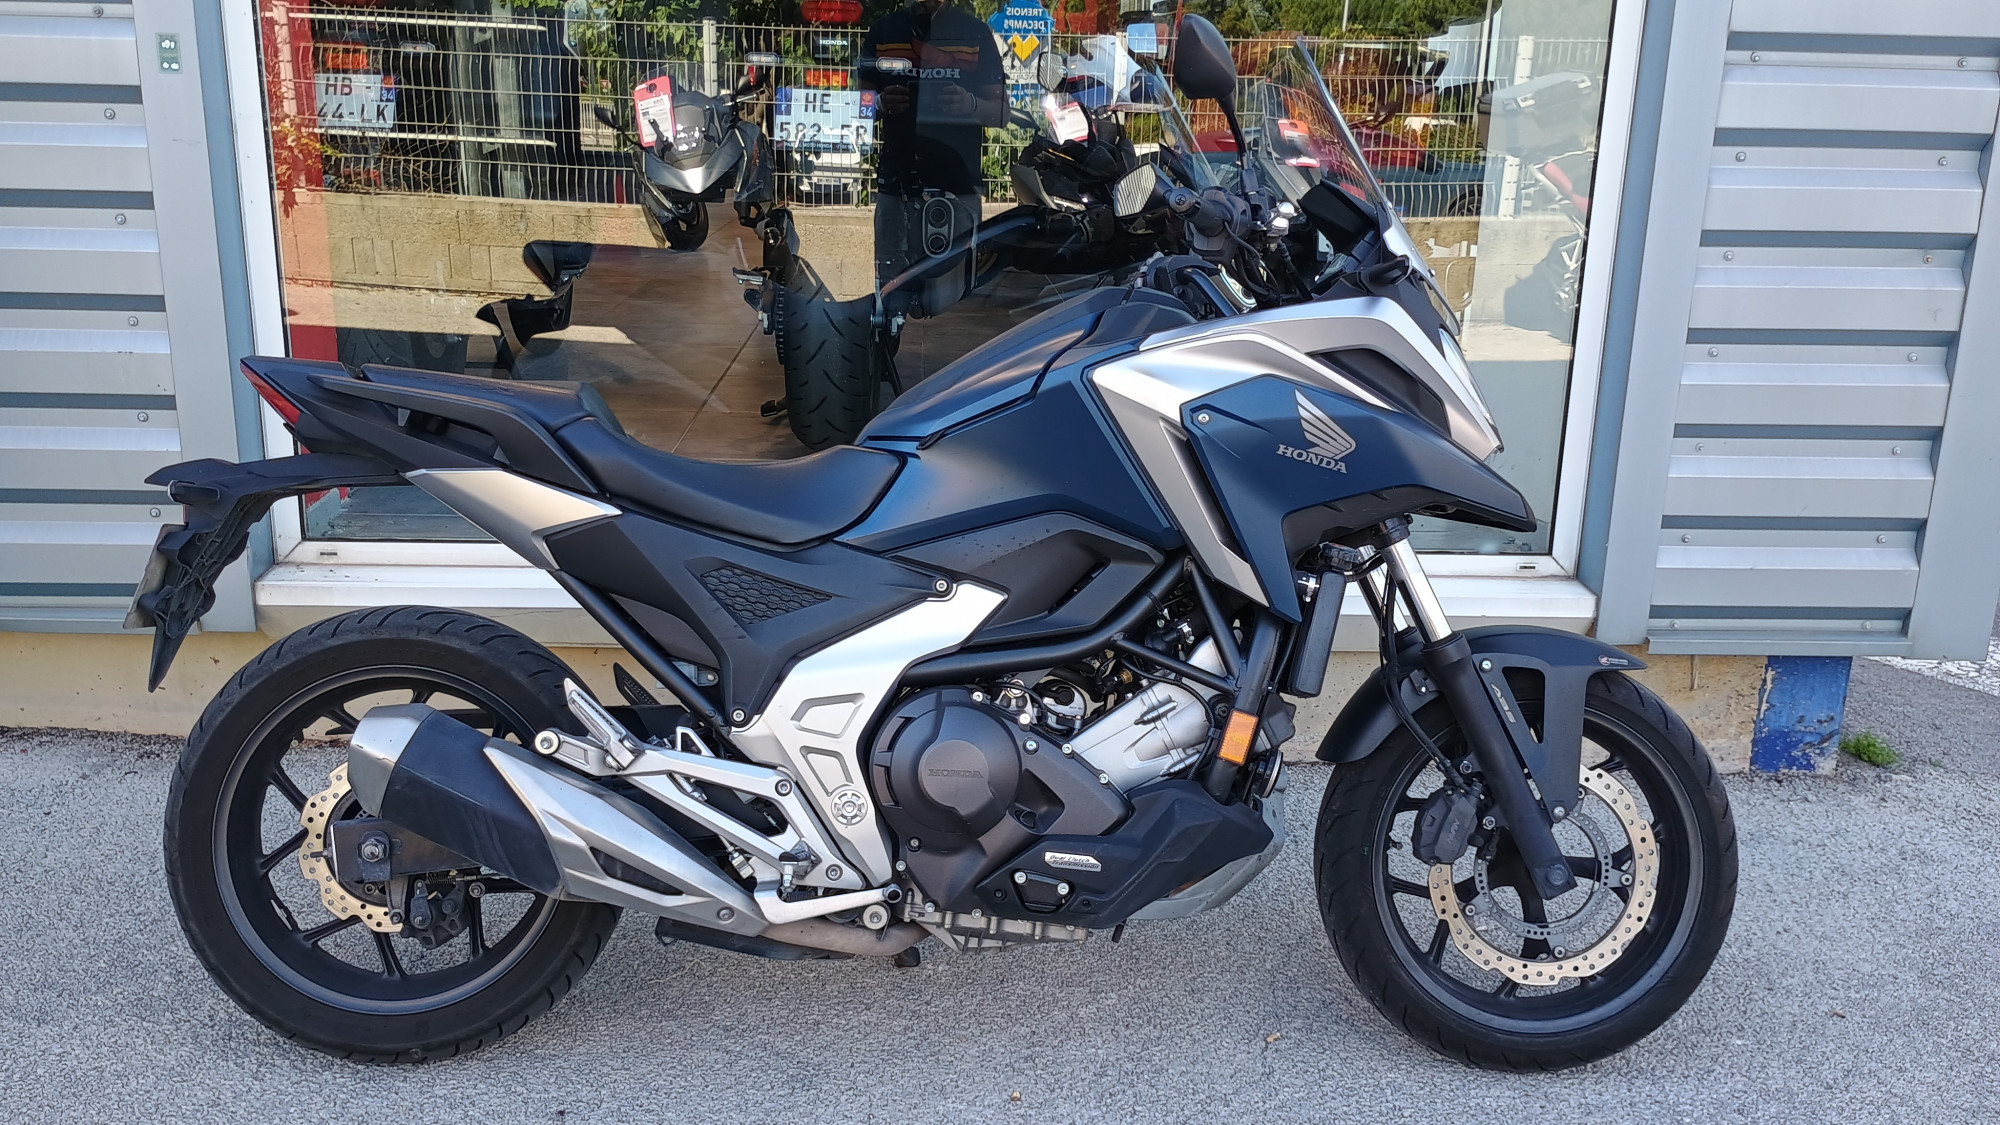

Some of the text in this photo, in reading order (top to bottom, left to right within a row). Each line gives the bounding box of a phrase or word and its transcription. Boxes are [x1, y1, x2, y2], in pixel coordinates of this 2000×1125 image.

[860, 106, 873, 117] 34
[1276, 444, 1347, 474] HONDA
[928, 768, 984, 779] HONDA
